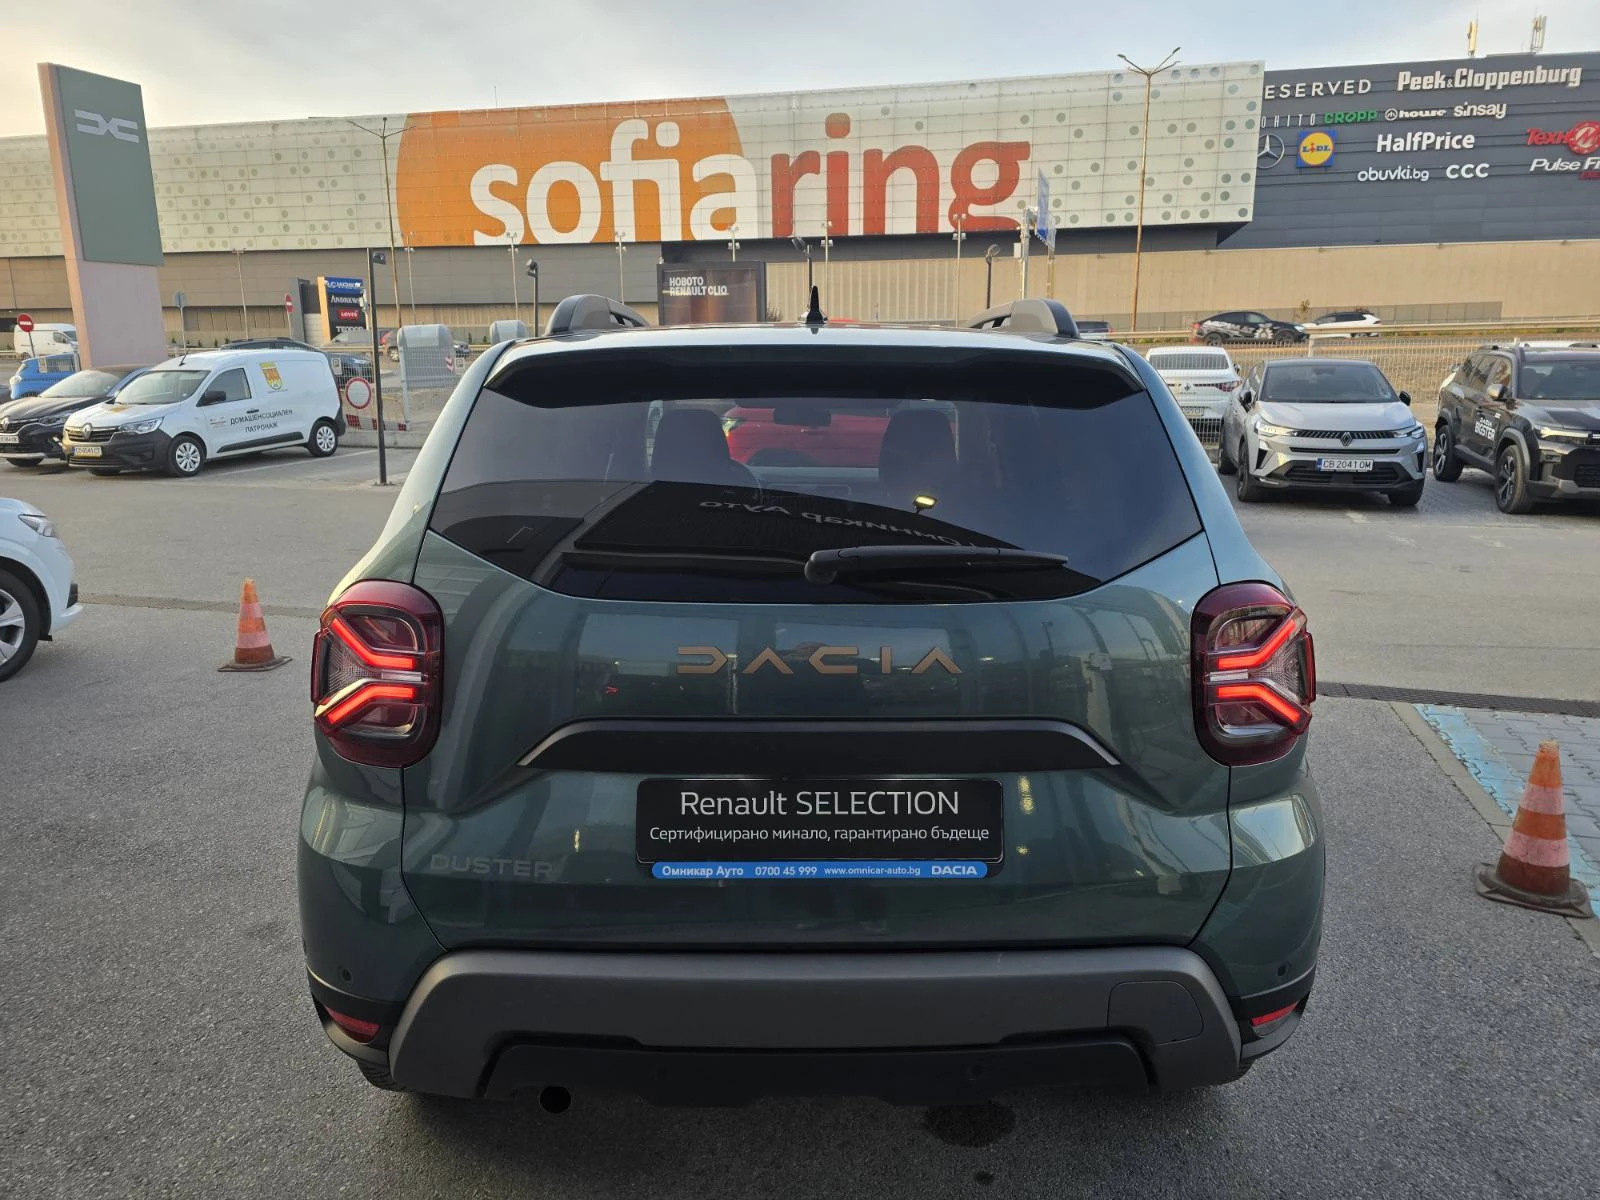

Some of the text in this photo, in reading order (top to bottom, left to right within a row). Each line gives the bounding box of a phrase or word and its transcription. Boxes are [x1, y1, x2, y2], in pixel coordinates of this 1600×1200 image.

[1264, 79, 1372, 100] ESERVED
[1324, 109, 1378, 125] CROPP
[1454, 101, 1507, 119] sinsay
[1261, 113, 1317, 129] OHITO
[1302, 142, 1331, 154] LIDL
[1376, 131, 1475, 153] HalfPrice
[1446, 163, 1489, 179] CCC
[1529, 158, 1581, 172] Pulse
[1357, 165, 1429, 183] obuvki.bg
[677, 646, 963, 674] DACIA
[680, 791, 960, 815] Renault SELECTION
[650, 825, 990, 842] Сертифицирано минало, гарантирано бъдеще
[430, 853, 553, 879] DUSTER
[662, 864, 977, 878] Омникар Ауто 0700 45 999 www.omnicar-auto.bg DACIA
